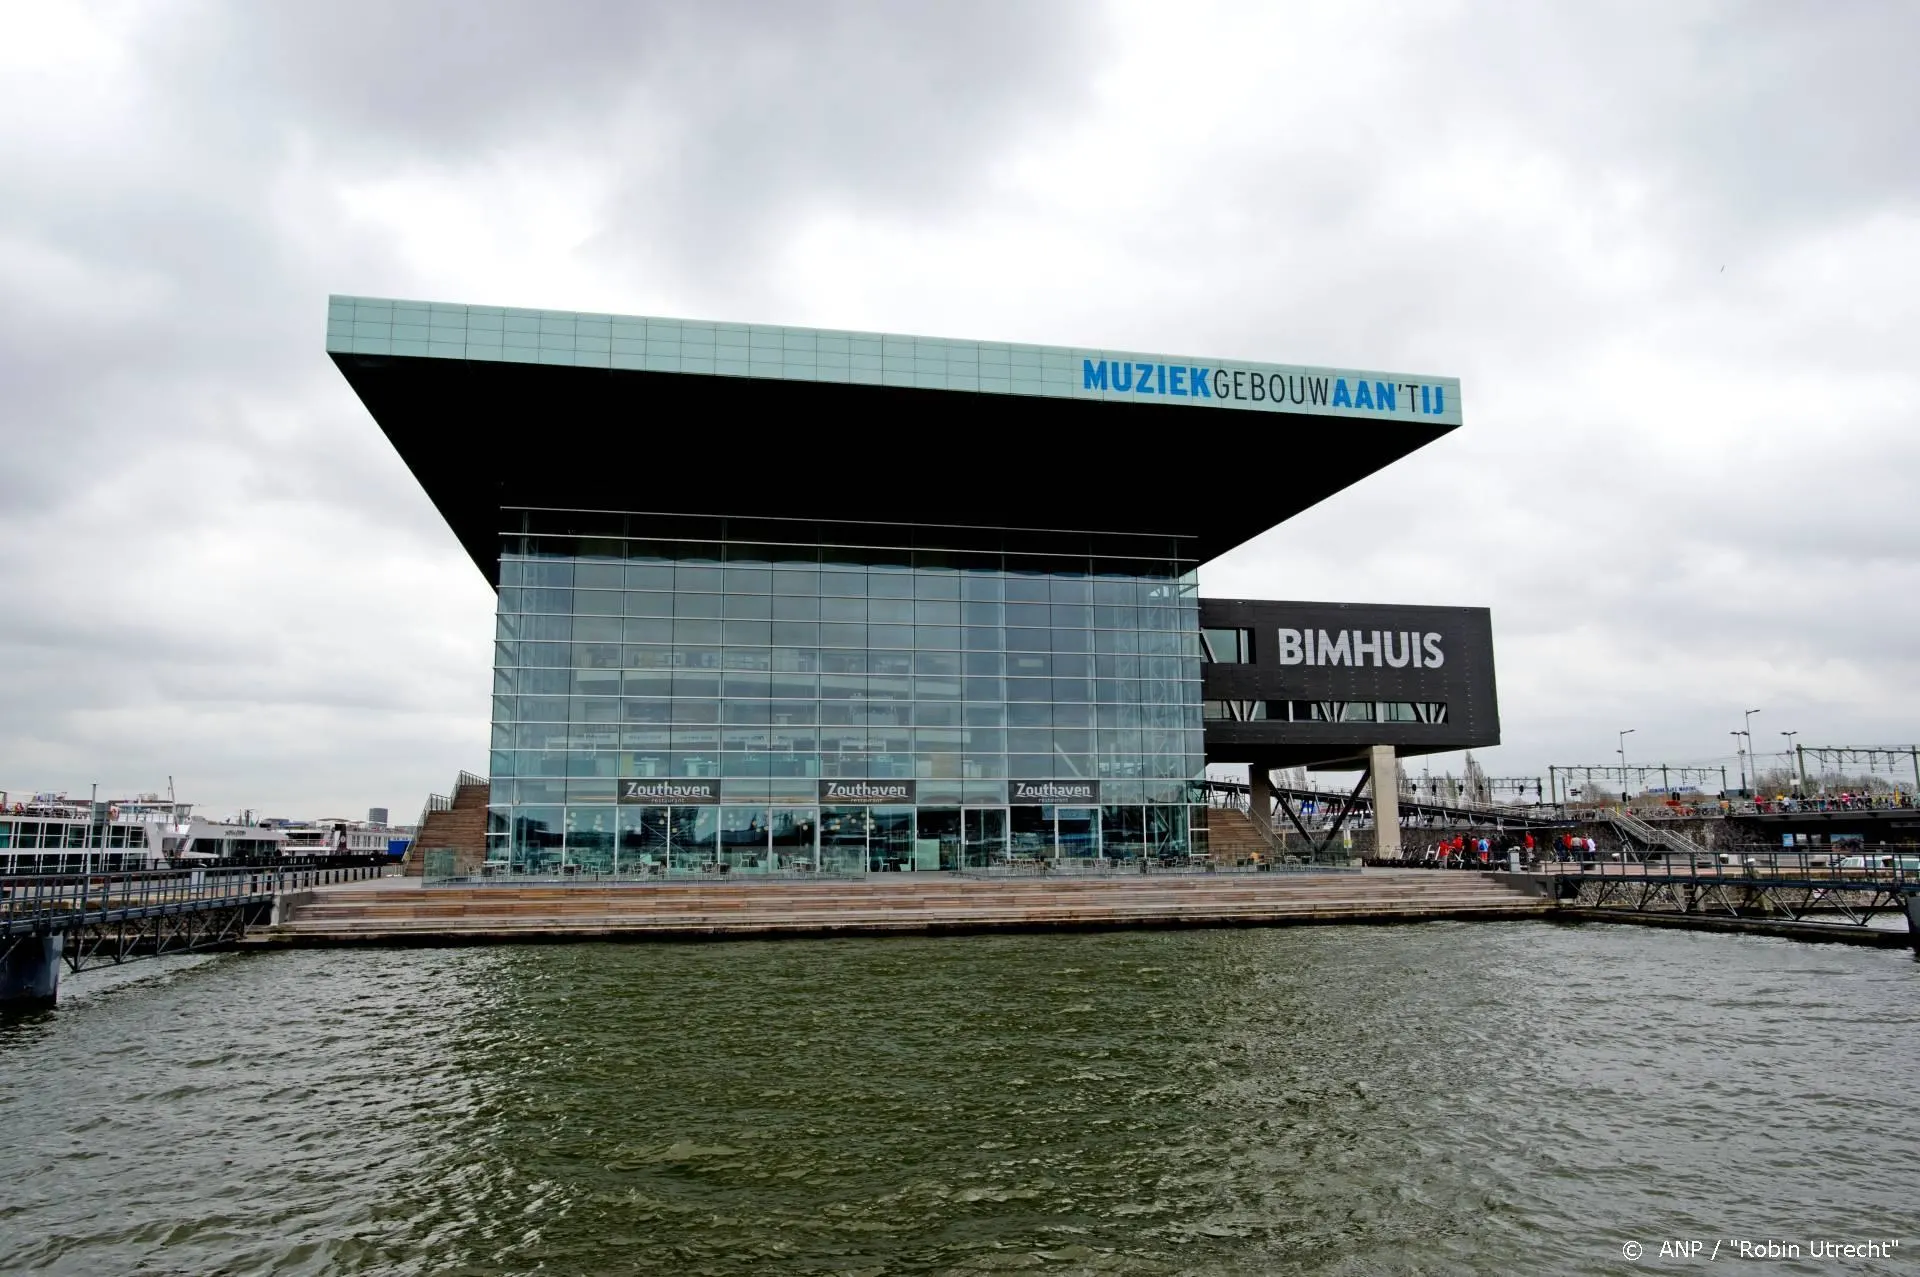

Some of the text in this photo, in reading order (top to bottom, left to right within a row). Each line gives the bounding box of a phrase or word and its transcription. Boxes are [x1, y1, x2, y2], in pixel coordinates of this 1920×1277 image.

[1278, 628, 1445, 669] BIMHUIS
[626, 781, 710, 796] Zouthaven
[827, 781, 907, 796] Zouthaven
[1016, 781, 1091, 796] Zouthaven
